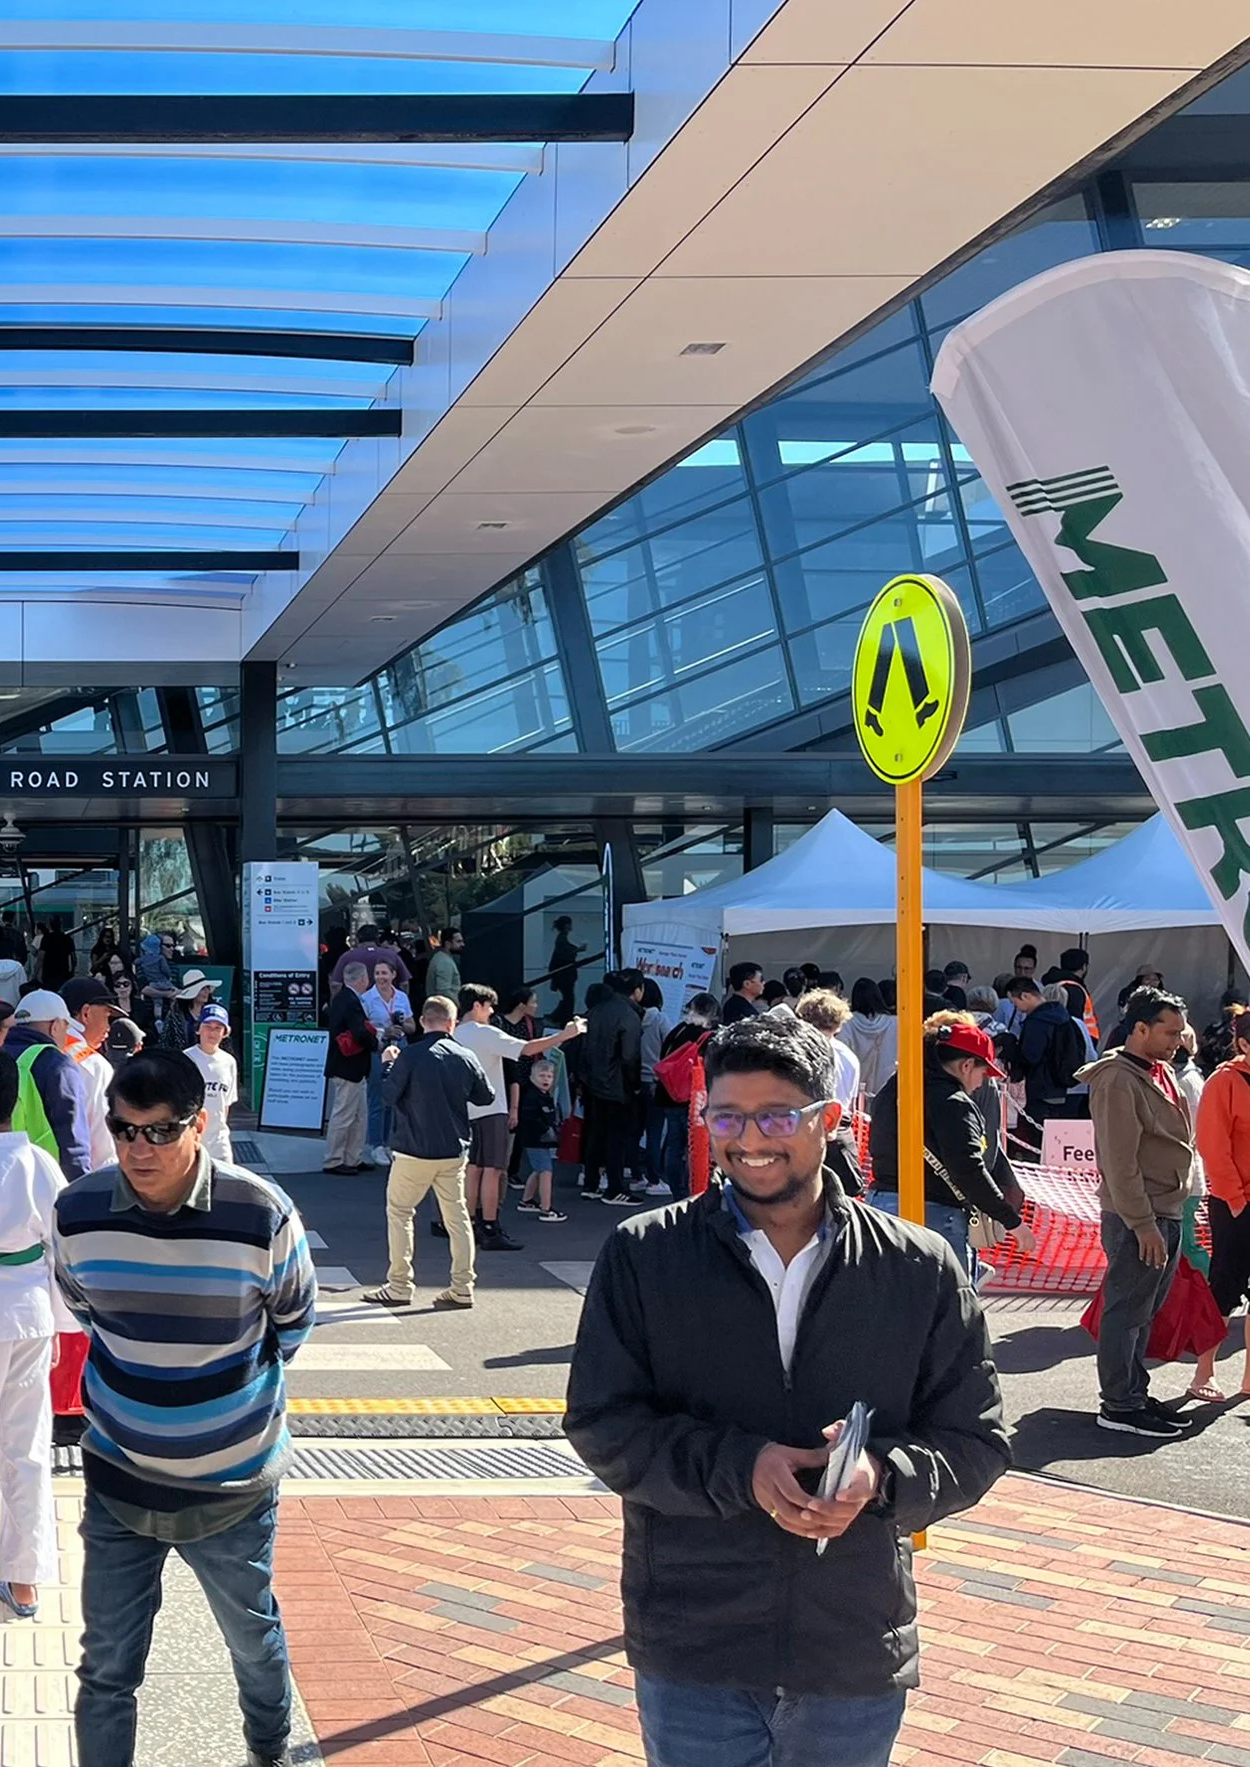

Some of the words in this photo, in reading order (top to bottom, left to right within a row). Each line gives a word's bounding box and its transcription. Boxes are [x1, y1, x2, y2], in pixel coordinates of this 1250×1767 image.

[1006, 466, 1250, 950] METR
[10, 771, 80, 788] ROAD
[101, 771, 211, 788] STATION
[274, 1034, 327, 1044] METRONET
